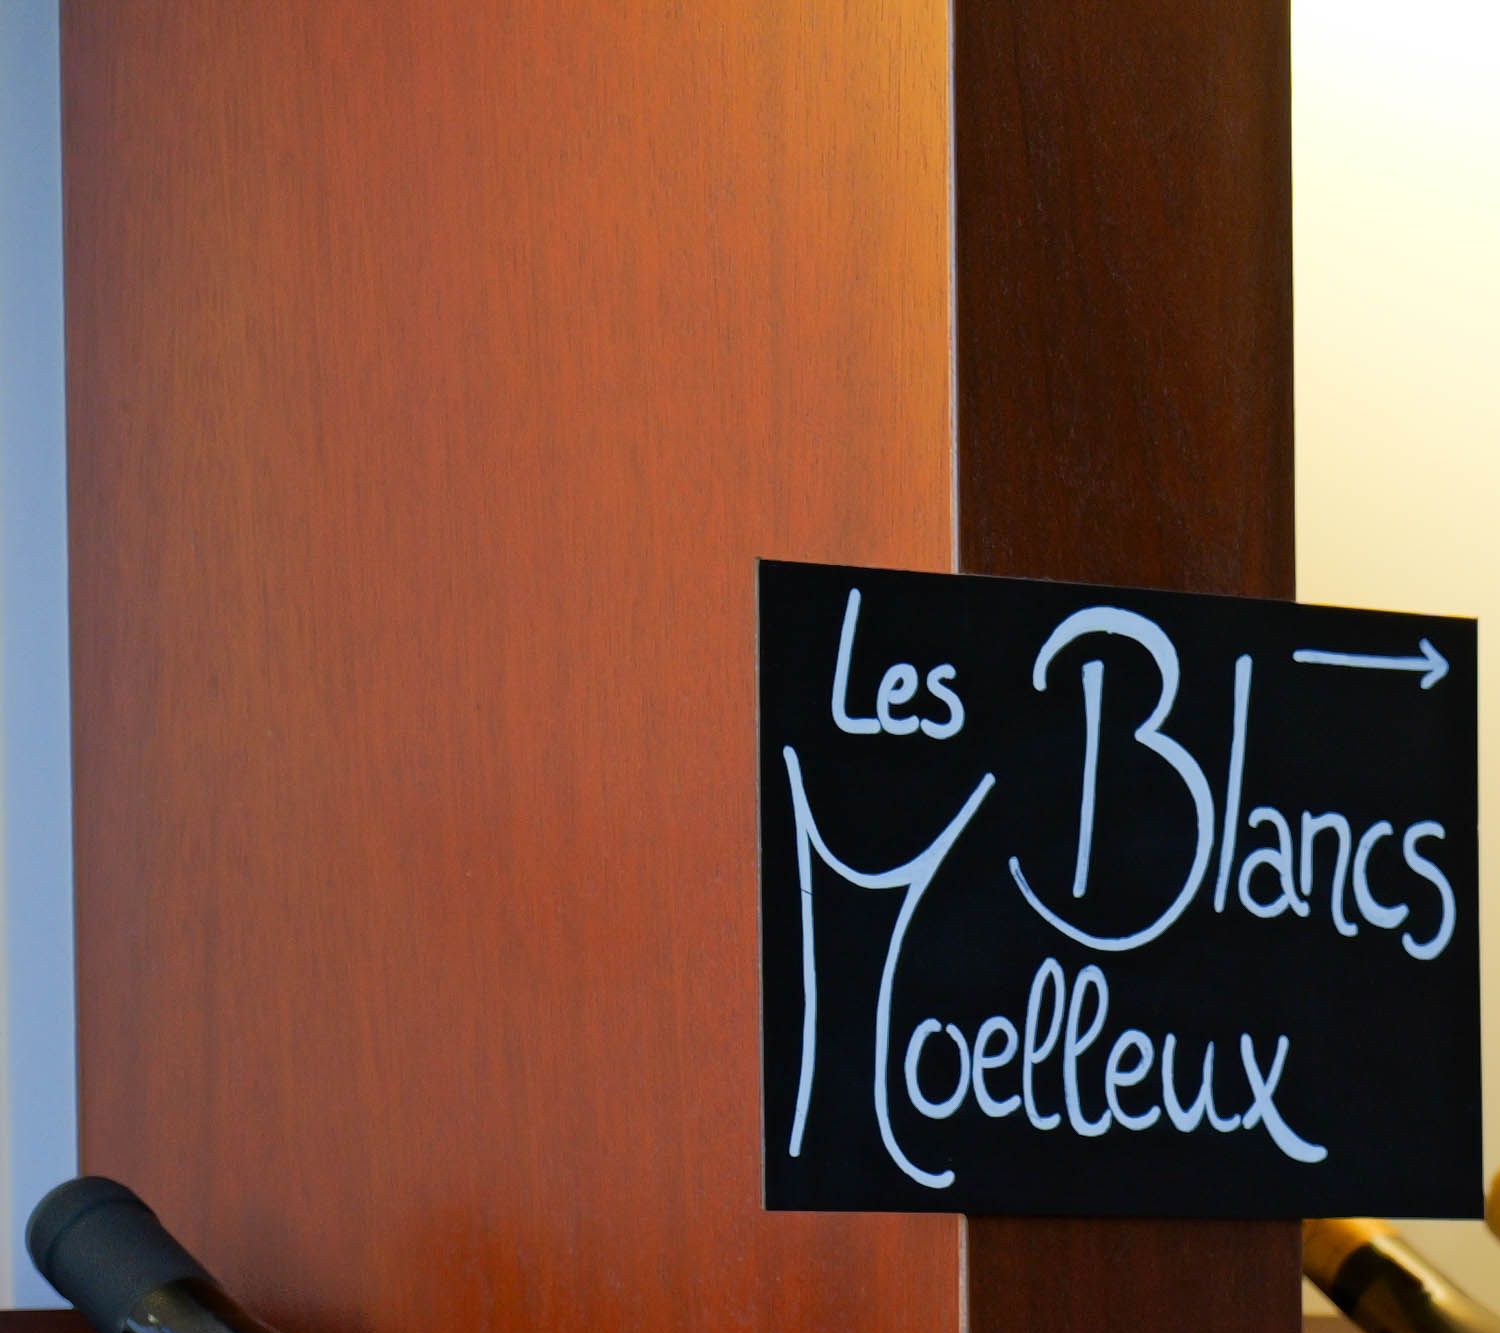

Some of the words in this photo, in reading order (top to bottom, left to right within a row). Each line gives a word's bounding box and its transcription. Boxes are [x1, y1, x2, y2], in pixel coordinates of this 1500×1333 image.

[782, 744, 1329, 1188] Moelleux
[831, 588, 965, 739] Les
[1009, 605, 1457, 960] Blancs
